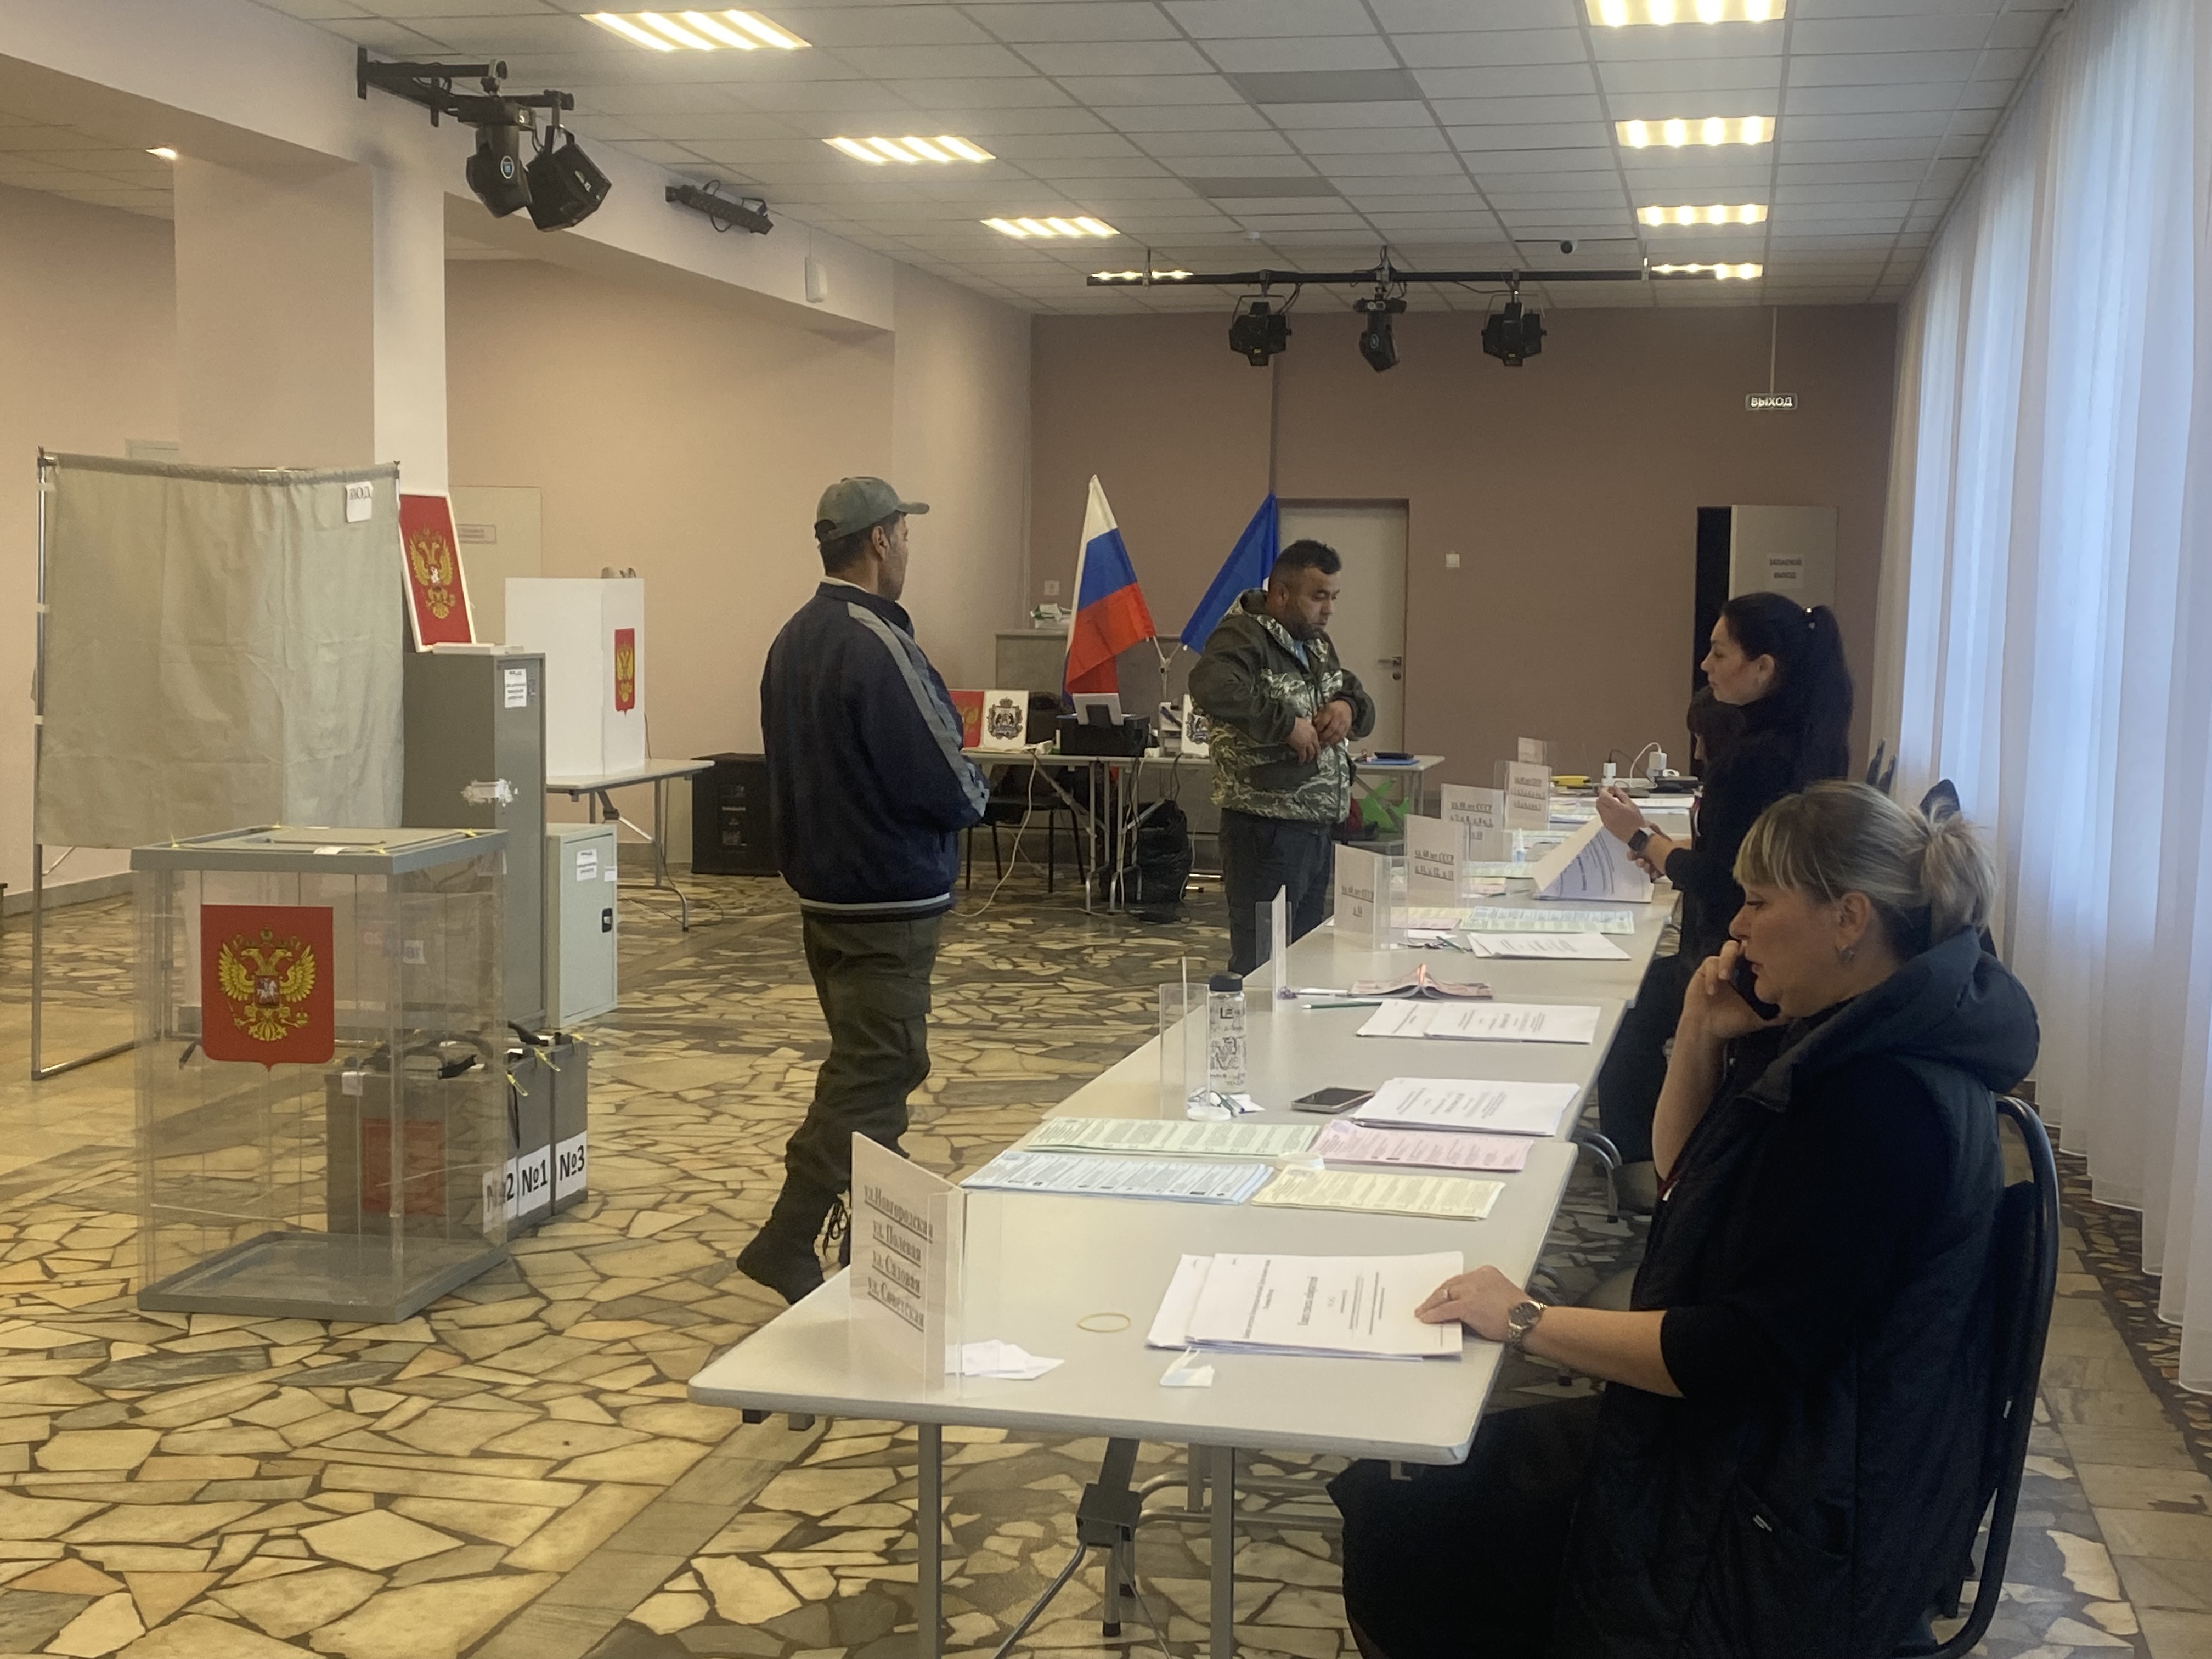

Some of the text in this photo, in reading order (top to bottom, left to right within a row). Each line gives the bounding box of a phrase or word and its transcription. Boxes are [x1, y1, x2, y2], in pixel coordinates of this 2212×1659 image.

[1751, 396, 1793, 407] ВЫХОД
[1438, 852, 1454, 862] СССР
[1361, 889, 1374, 900] СССР
[522, 1159, 548, 1197] №1
[560, 1144, 585, 1181] №3
[872, 1220, 921, 1262] ул. Полевая
[872, 1250, 921, 1294] ул. Садовая
[880, 1282, 924, 1328] Советская
